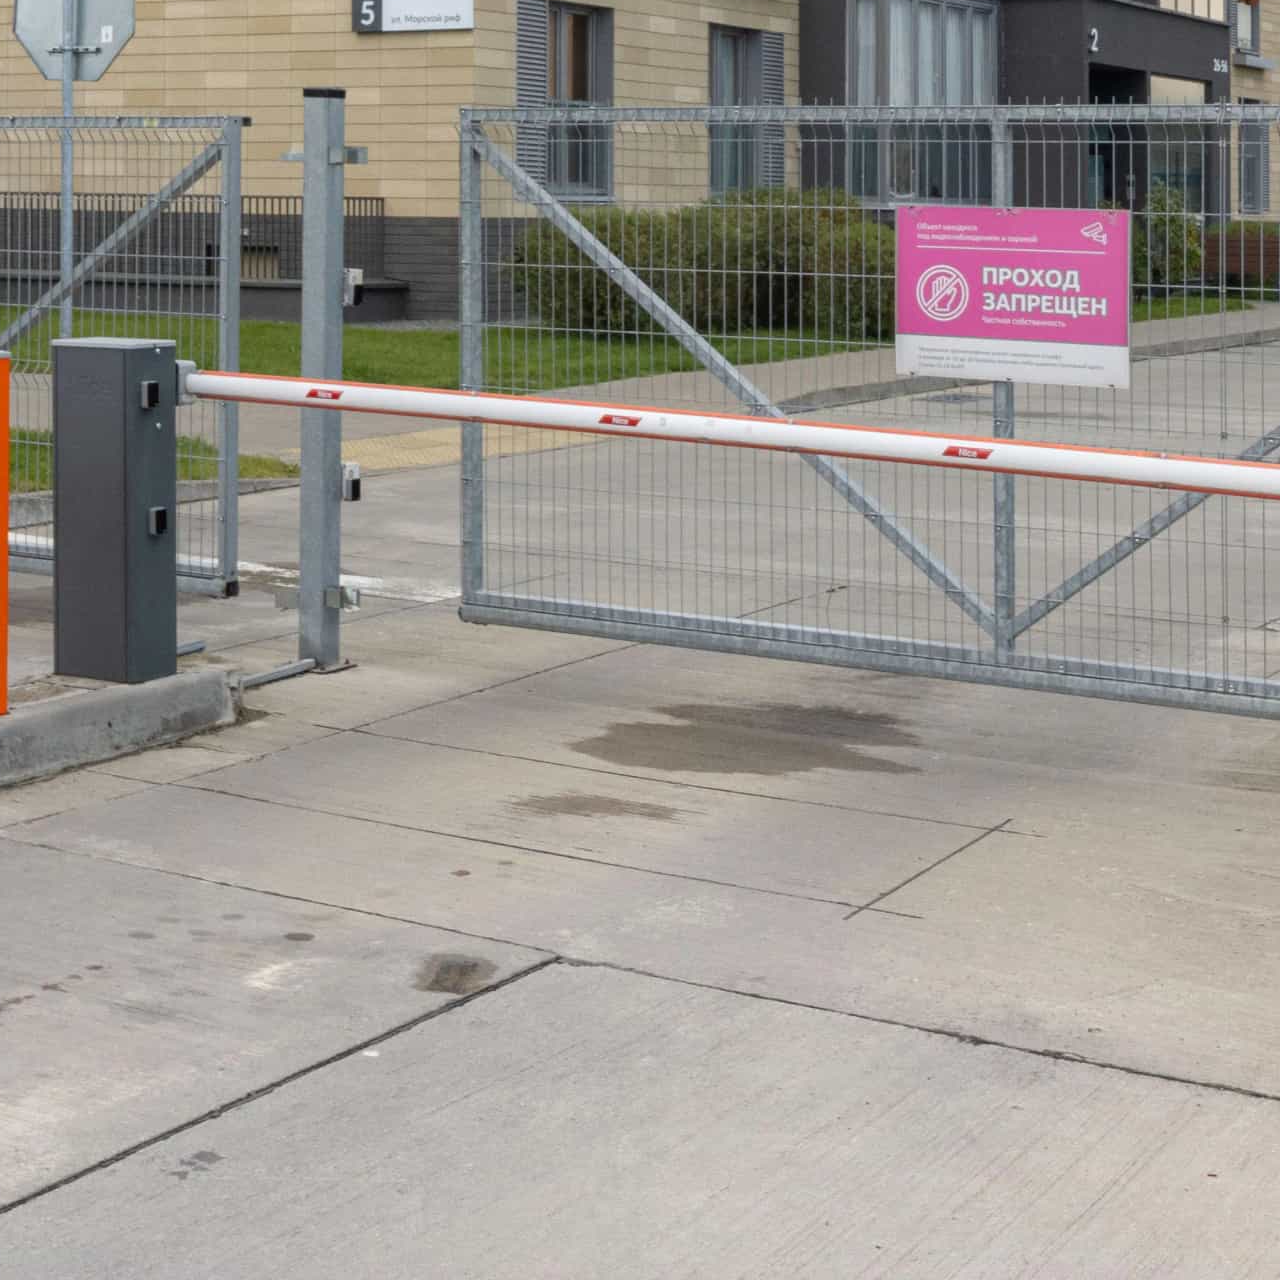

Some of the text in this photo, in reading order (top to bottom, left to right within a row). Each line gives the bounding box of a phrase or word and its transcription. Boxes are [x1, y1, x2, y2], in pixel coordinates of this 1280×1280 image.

[360, 0, 375, 26] 5
[1090, 28, 1099, 52] 2
[982, 266, 1080, 293] ПРОХОД
[982, 292, 1107, 319] ЗАПРЕЩЕН
